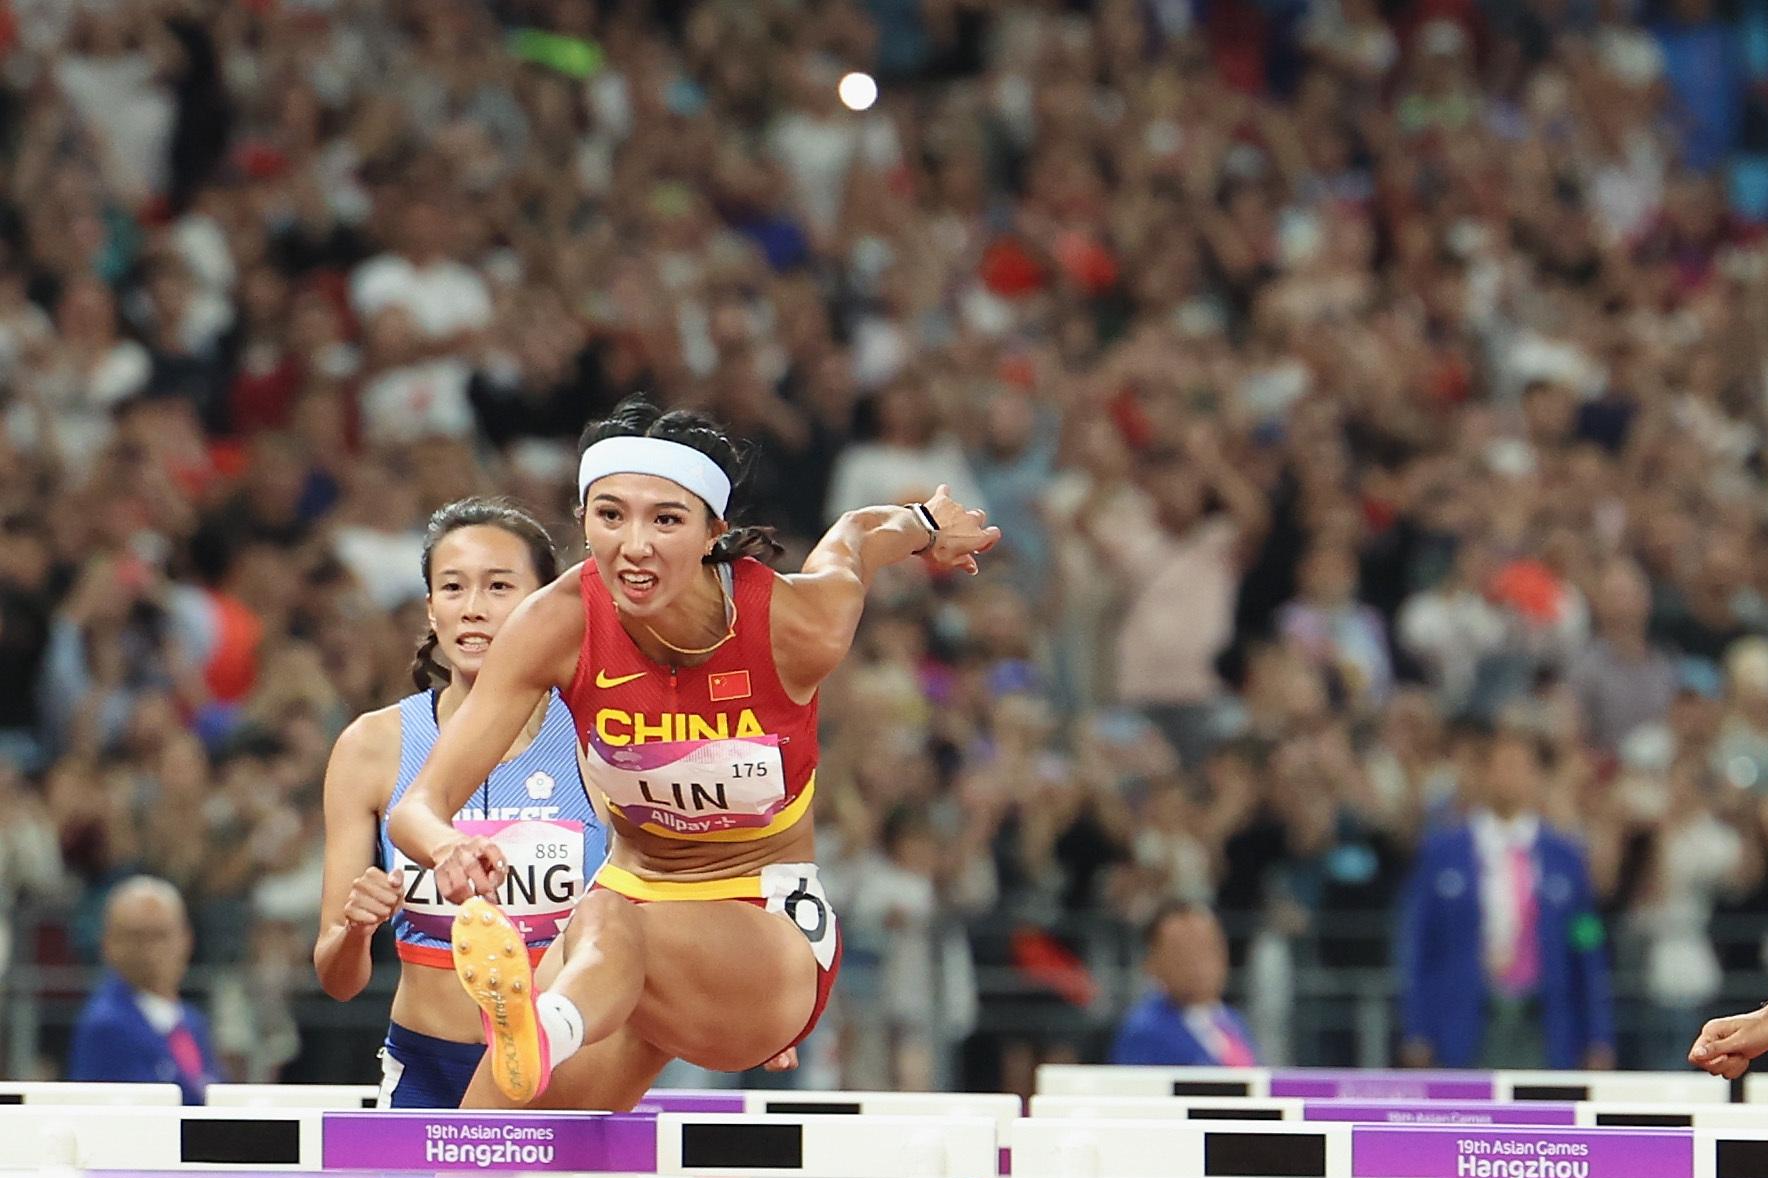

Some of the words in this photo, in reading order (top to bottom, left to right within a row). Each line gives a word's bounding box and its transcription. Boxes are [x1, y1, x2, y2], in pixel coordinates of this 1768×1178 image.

[596, 708, 766, 747] CHINA
[732, 762, 768, 778] 175
[638, 780, 729, 811] LIN
[535, 844, 569, 859] 885
[403, 864, 575, 905] ZNG
[784, 877, 827, 943] 6
[425, 1124, 458, 1139] 19th
[460, 1125, 501, 1139] Asian
[502, 1125, 554, 1140] Games
[426, 1139, 554, 1167] Hangzhou
[1457, 1139, 1491, 1154] 19th
[1492, 1140, 1535, 1155] Asian
[1536, 1141, 1589, 1156] Games
